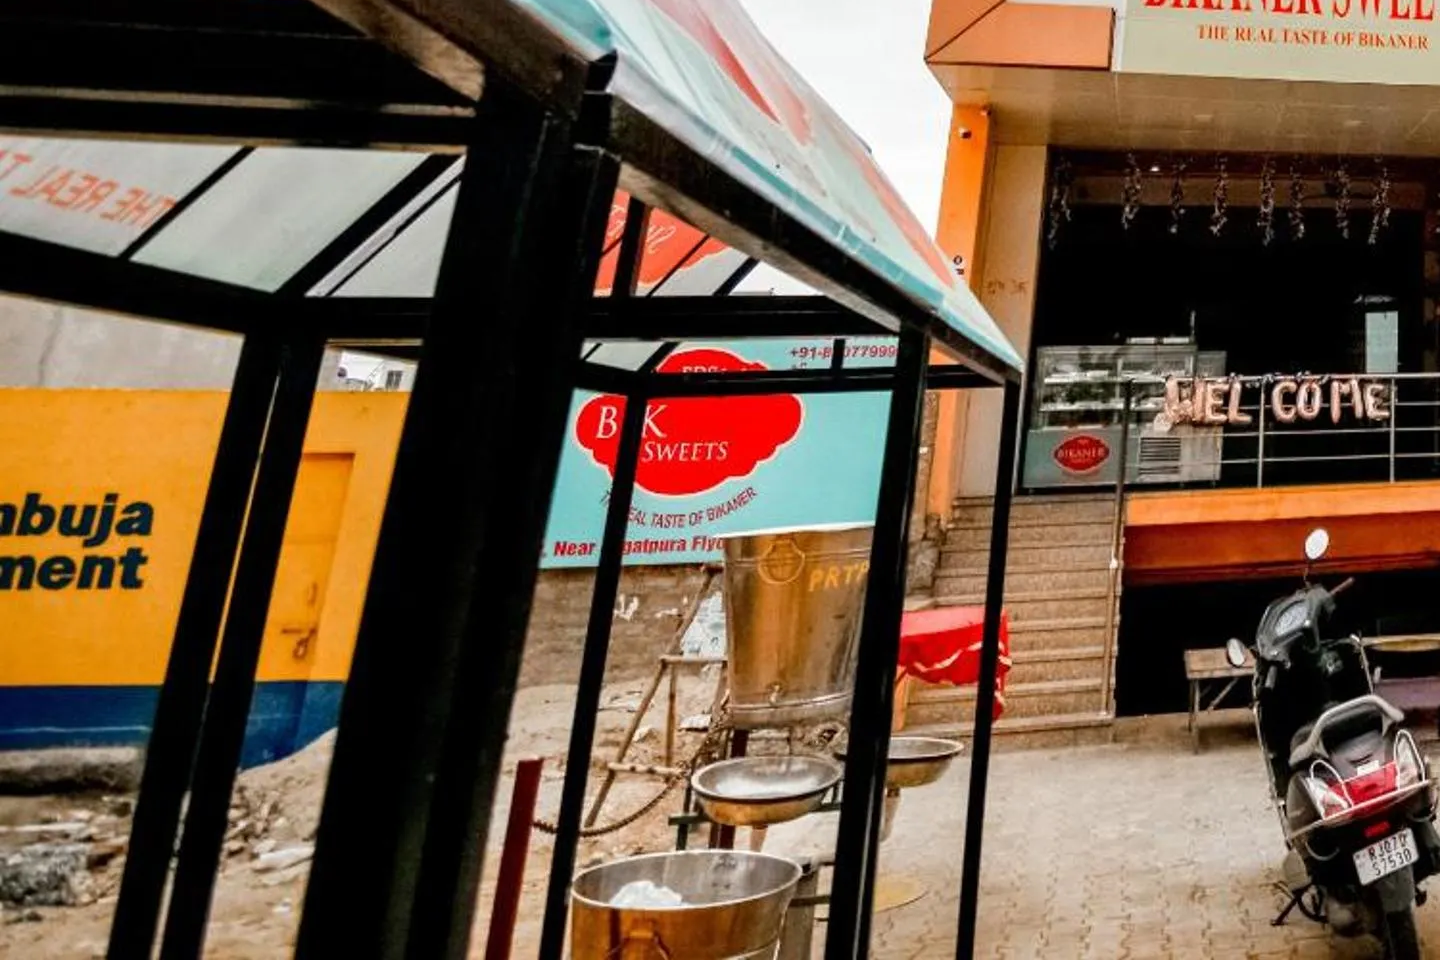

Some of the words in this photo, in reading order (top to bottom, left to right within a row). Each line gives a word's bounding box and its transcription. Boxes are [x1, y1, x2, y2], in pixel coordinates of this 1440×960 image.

[1198, 24, 1228, 41] THE
[1236, 26, 1276, 43] REAL
[1283, 28, 1328, 46] TASTE
[1334, 31, 1355, 47] OF
[1358, 32, 1429, 50] BIKANER
[641, 440, 729, 463] SWEETS
[554, 541, 597, 557] Near
